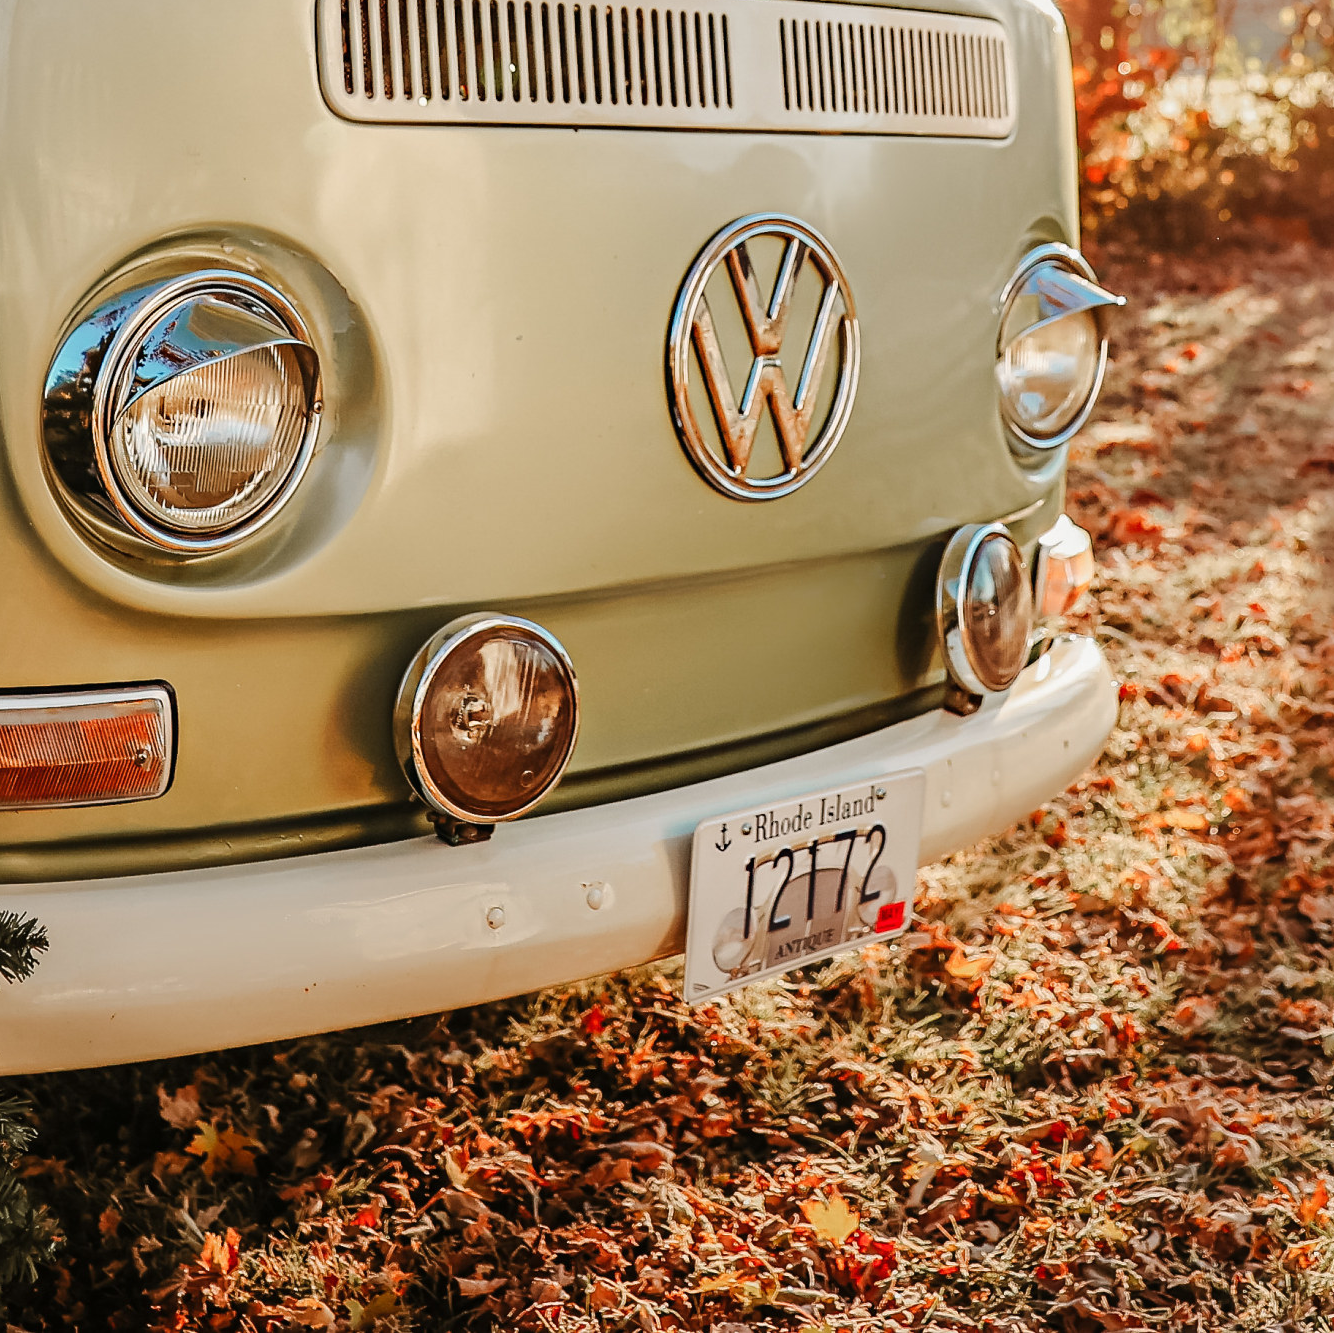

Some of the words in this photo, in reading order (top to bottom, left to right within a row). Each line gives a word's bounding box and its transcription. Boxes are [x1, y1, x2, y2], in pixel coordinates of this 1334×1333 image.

[683, 230, 851, 482] VW
[754, 803, 814, 843] Rhode
[819, 785, 876, 826] Island
[744, 823, 887, 940] 12172
[774, 928, 835, 960] ANTIQUE
